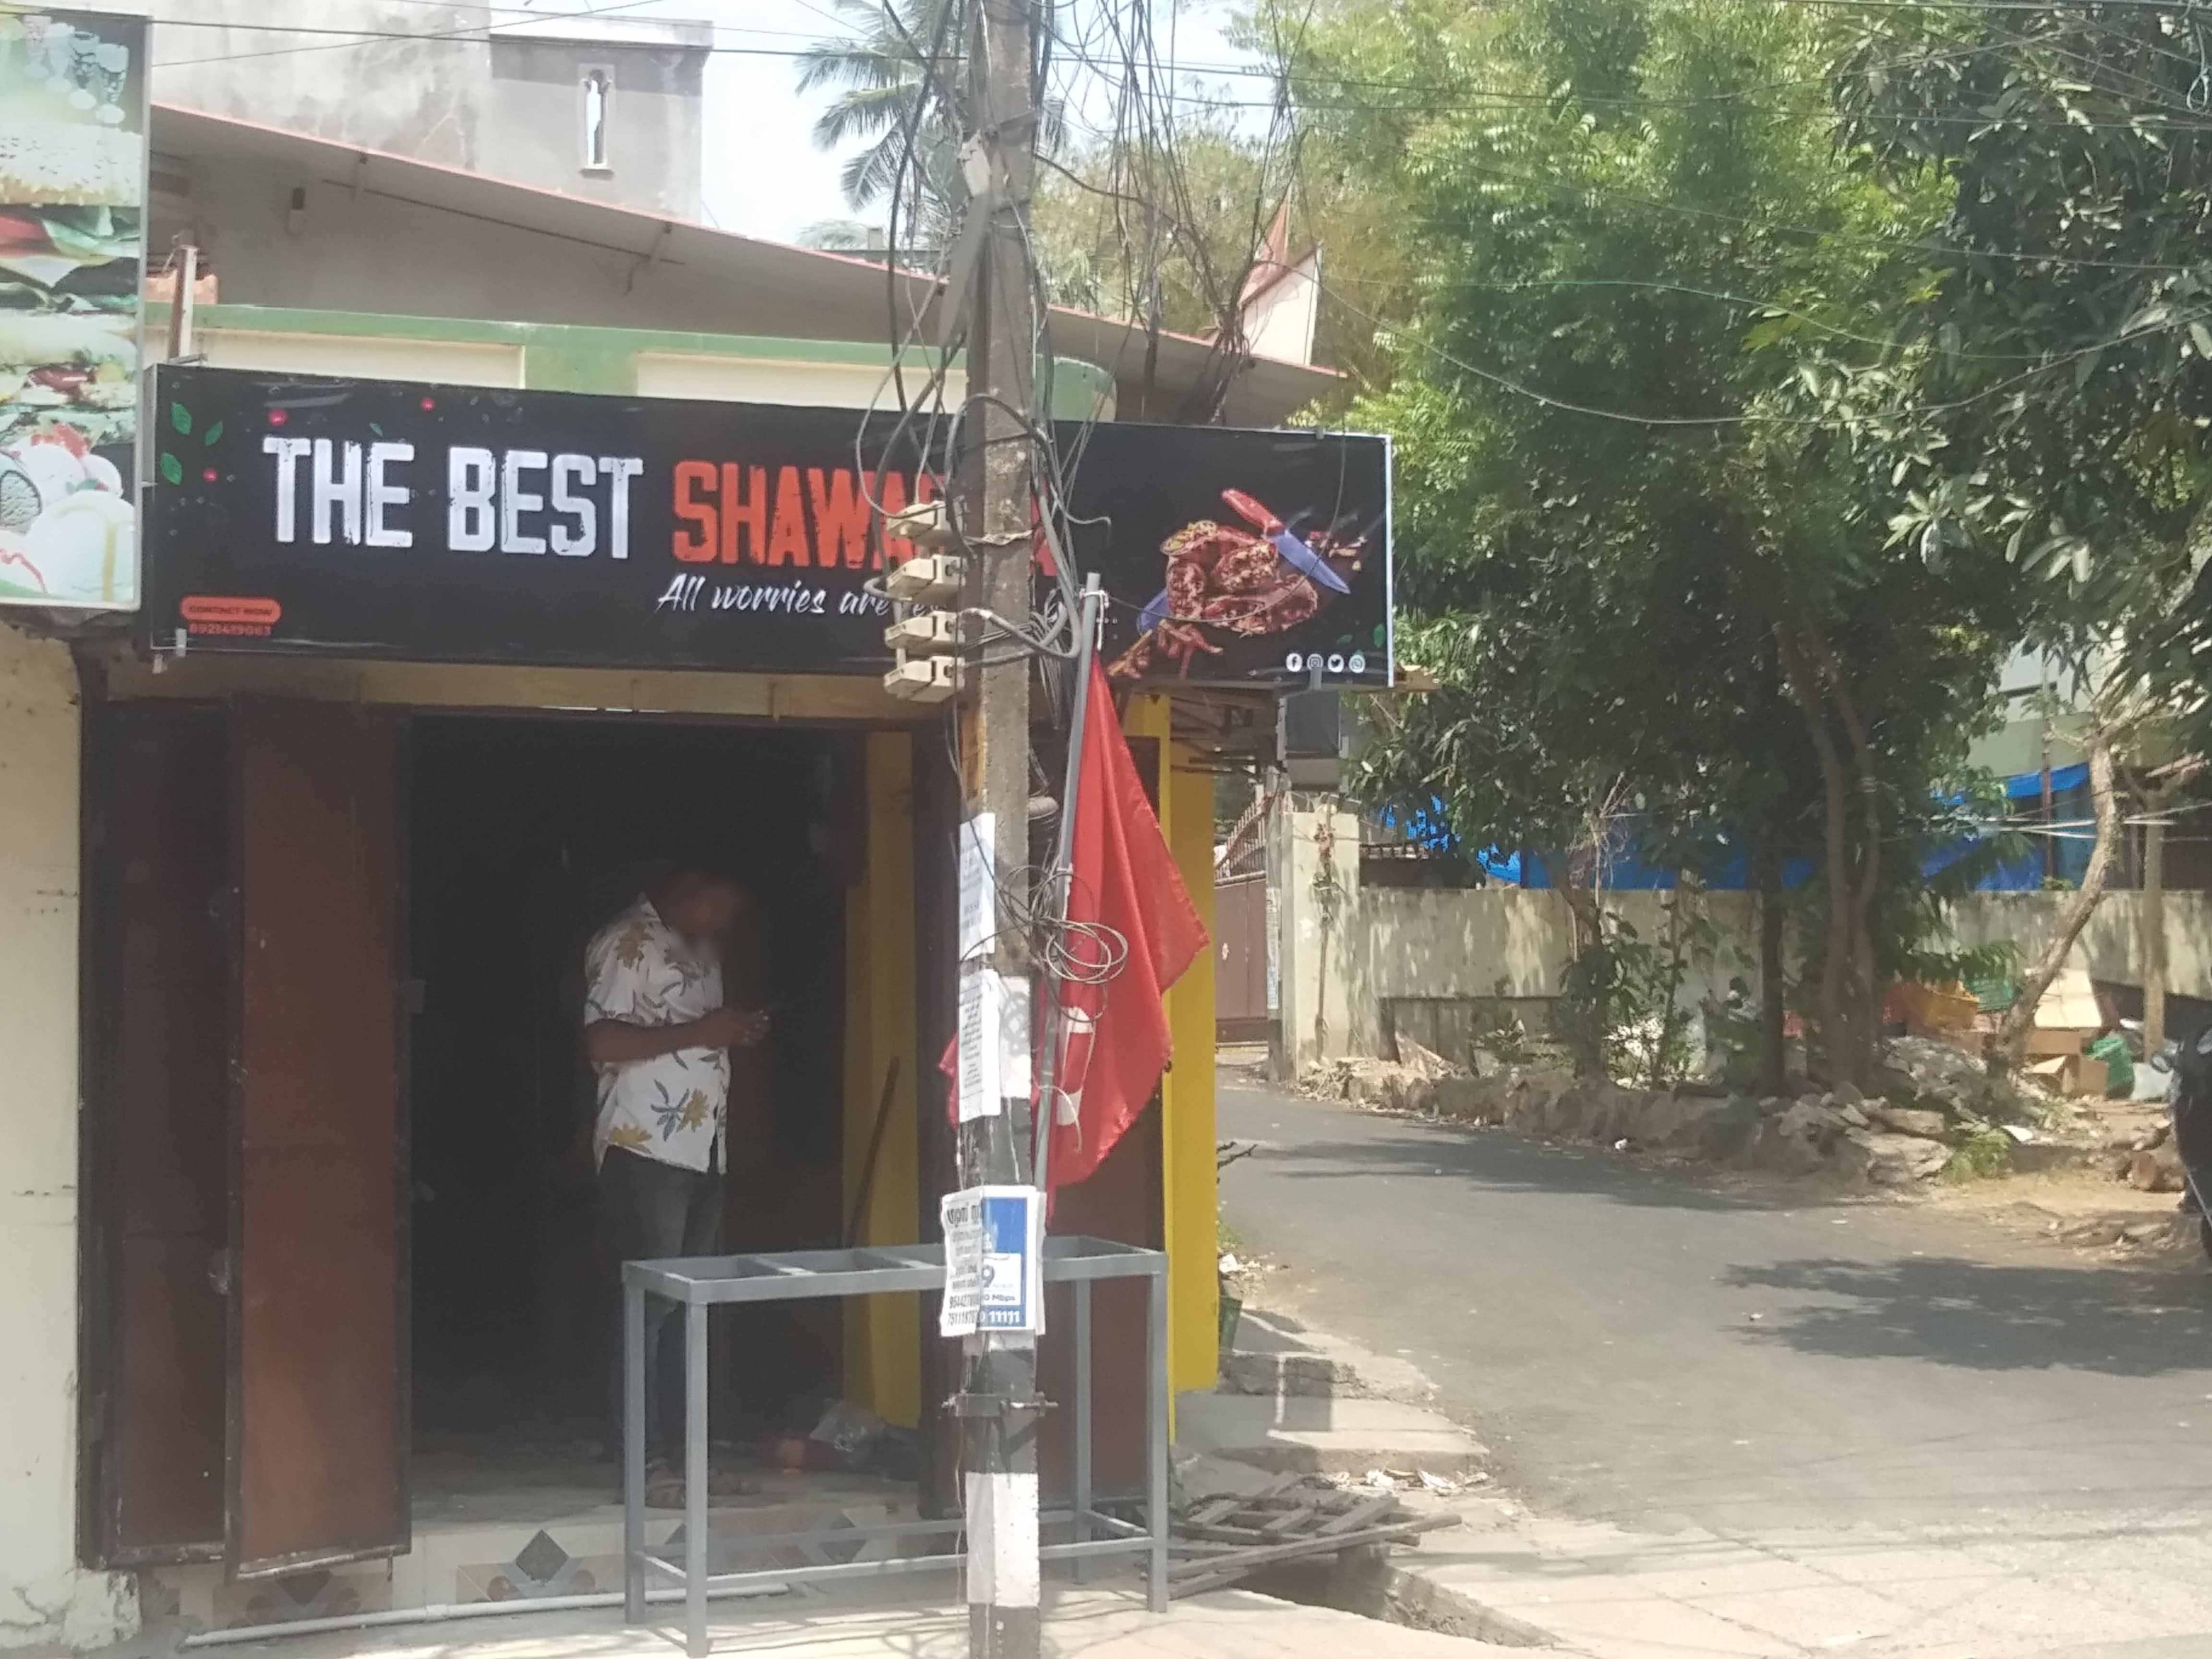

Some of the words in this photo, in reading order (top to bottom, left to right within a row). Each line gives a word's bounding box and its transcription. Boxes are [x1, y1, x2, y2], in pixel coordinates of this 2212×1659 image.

[263, 437, 415, 548] THE
[448, 446, 644, 560] BEST
[654, 574, 706, 612] All
[711, 581, 827, 614] worries
[840, 591, 889, 615] are
